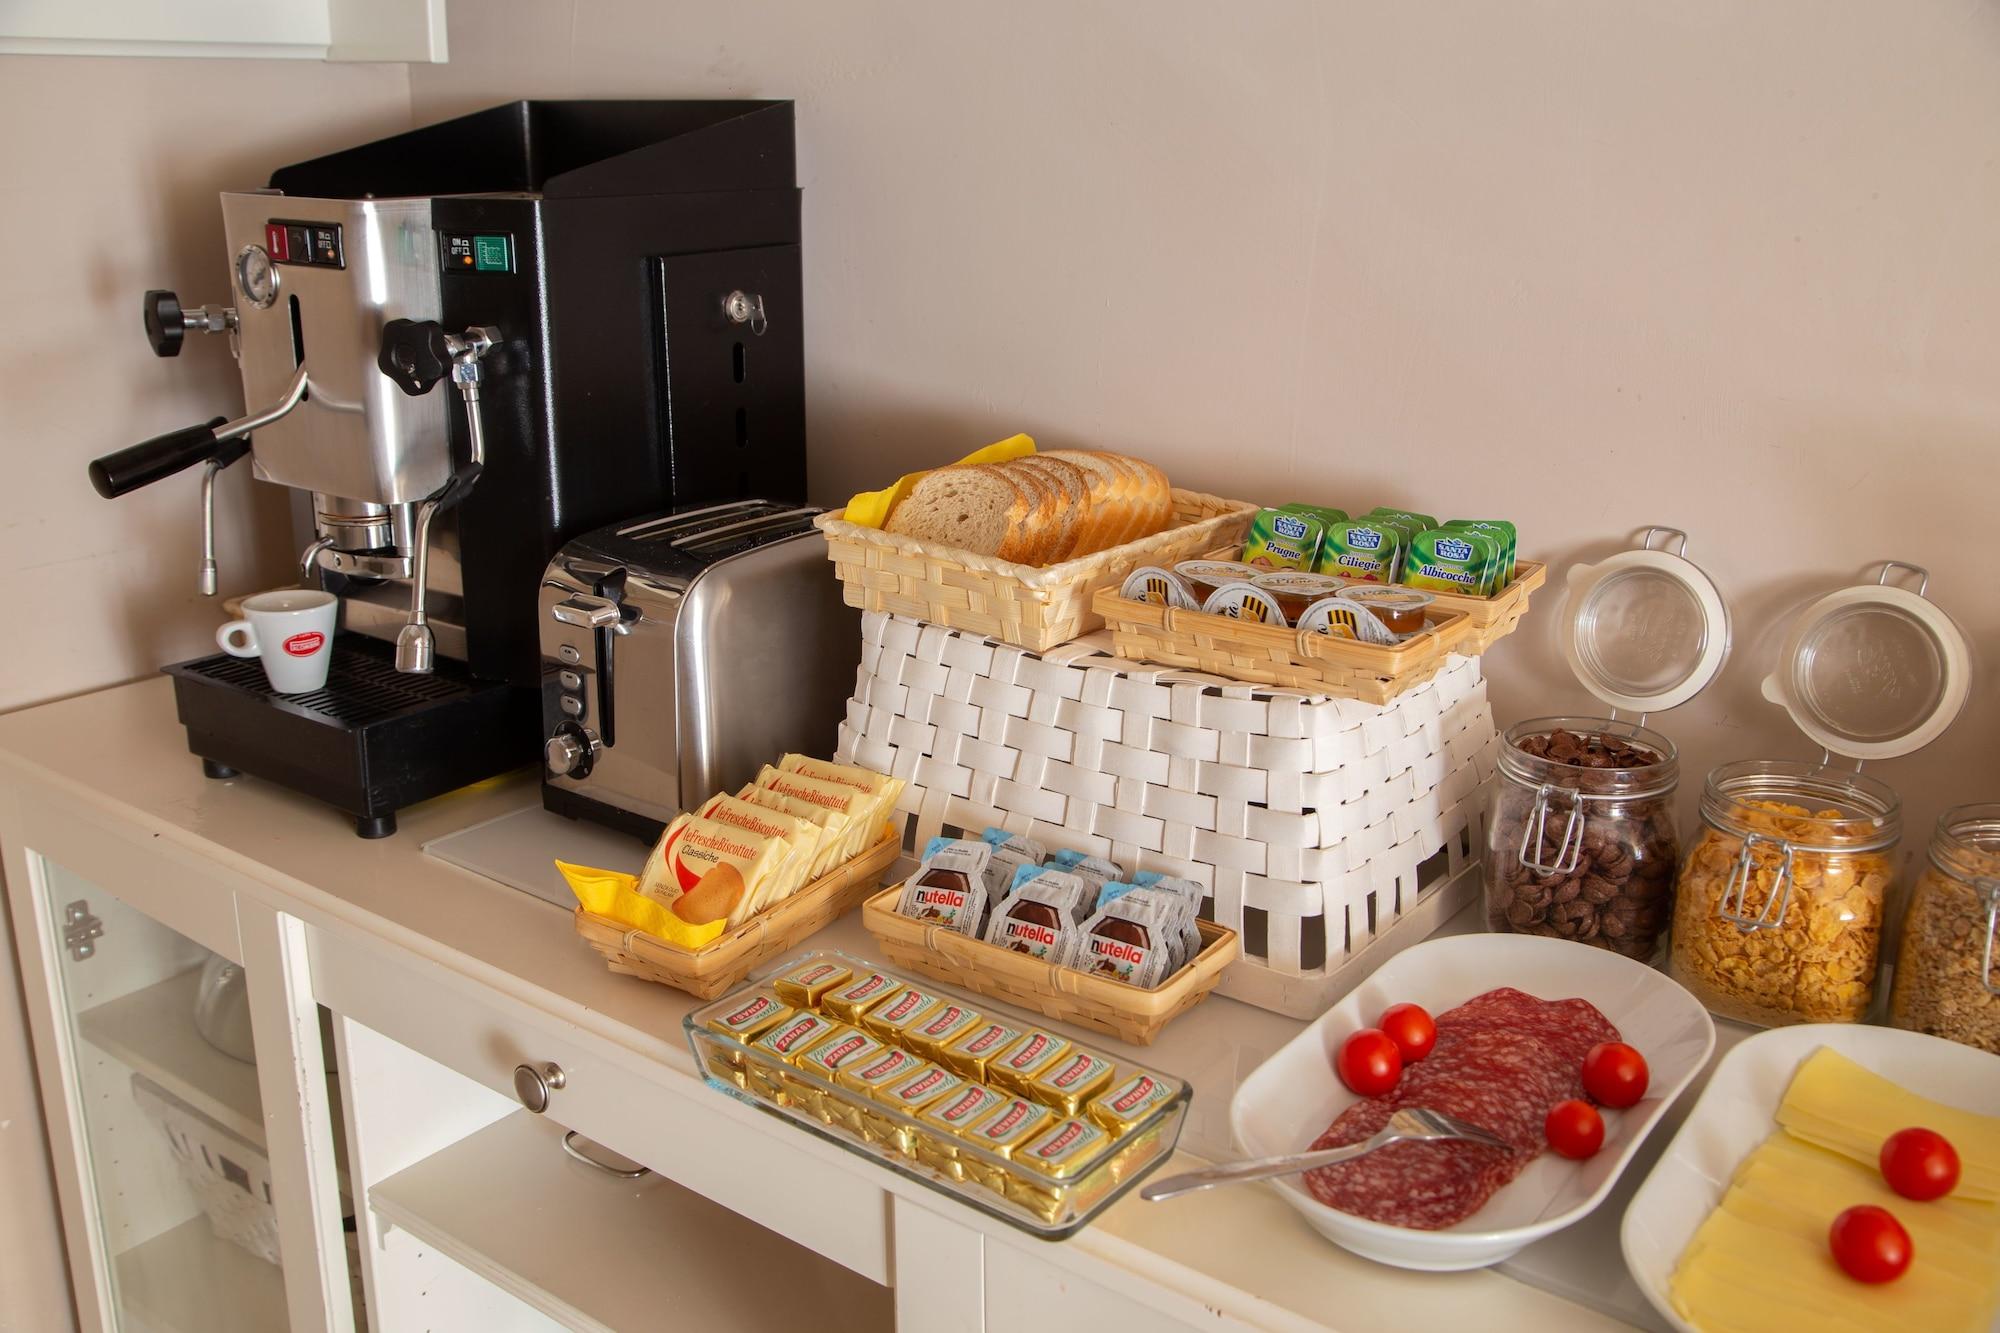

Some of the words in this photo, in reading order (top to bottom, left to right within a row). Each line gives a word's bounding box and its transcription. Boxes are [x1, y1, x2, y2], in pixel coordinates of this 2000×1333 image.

[1276, 520, 1303, 533] SANTA
[1278, 526, 1300, 537] ROSA
[1350, 533, 1378, 542] SANTA
[1266, 541, 1301, 559] Prugne
[1352, 540, 1375, 548] ROSA
[1438, 543, 1469, 554] SANTA
[1440, 550, 1465, 559] ROSA
[1338, 555, 1381, 571] Ciliegie
[1419, 565, 1476, 584] Albicocche
[682, 844, 720, 863] Classiche
[916, 889, 965, 908] nutella
[1006, 922, 1055, 945] nutella
[1091, 939, 1143, 964] nutella
[850, 979, 880, 998] ZANASI
[732, 1001, 766, 1022] ZANASI
[890, 994, 919, 1019] ZANASI
[933, 1010, 958, 1033] ZANASI
[780, 1022, 812, 1049] ZANASI
[972, 1028, 1000, 1050] ZANASI
[827, 1040, 860, 1064] ZANASI
[1015, 1037, 1043, 1066] ZANASI
[868, 1054, 900, 1077] ZANASI
[1060, 1059, 1089, 1085] ZANASI
[907, 1072, 941, 1096] ZANASI
[1119, 1080, 1149, 1109] ZANASI
[950, 1091, 980, 1119] ZANASI
[992, 1106, 1025, 1135] ZANASI
[1045, 1124, 1079, 1154] ZANASI
